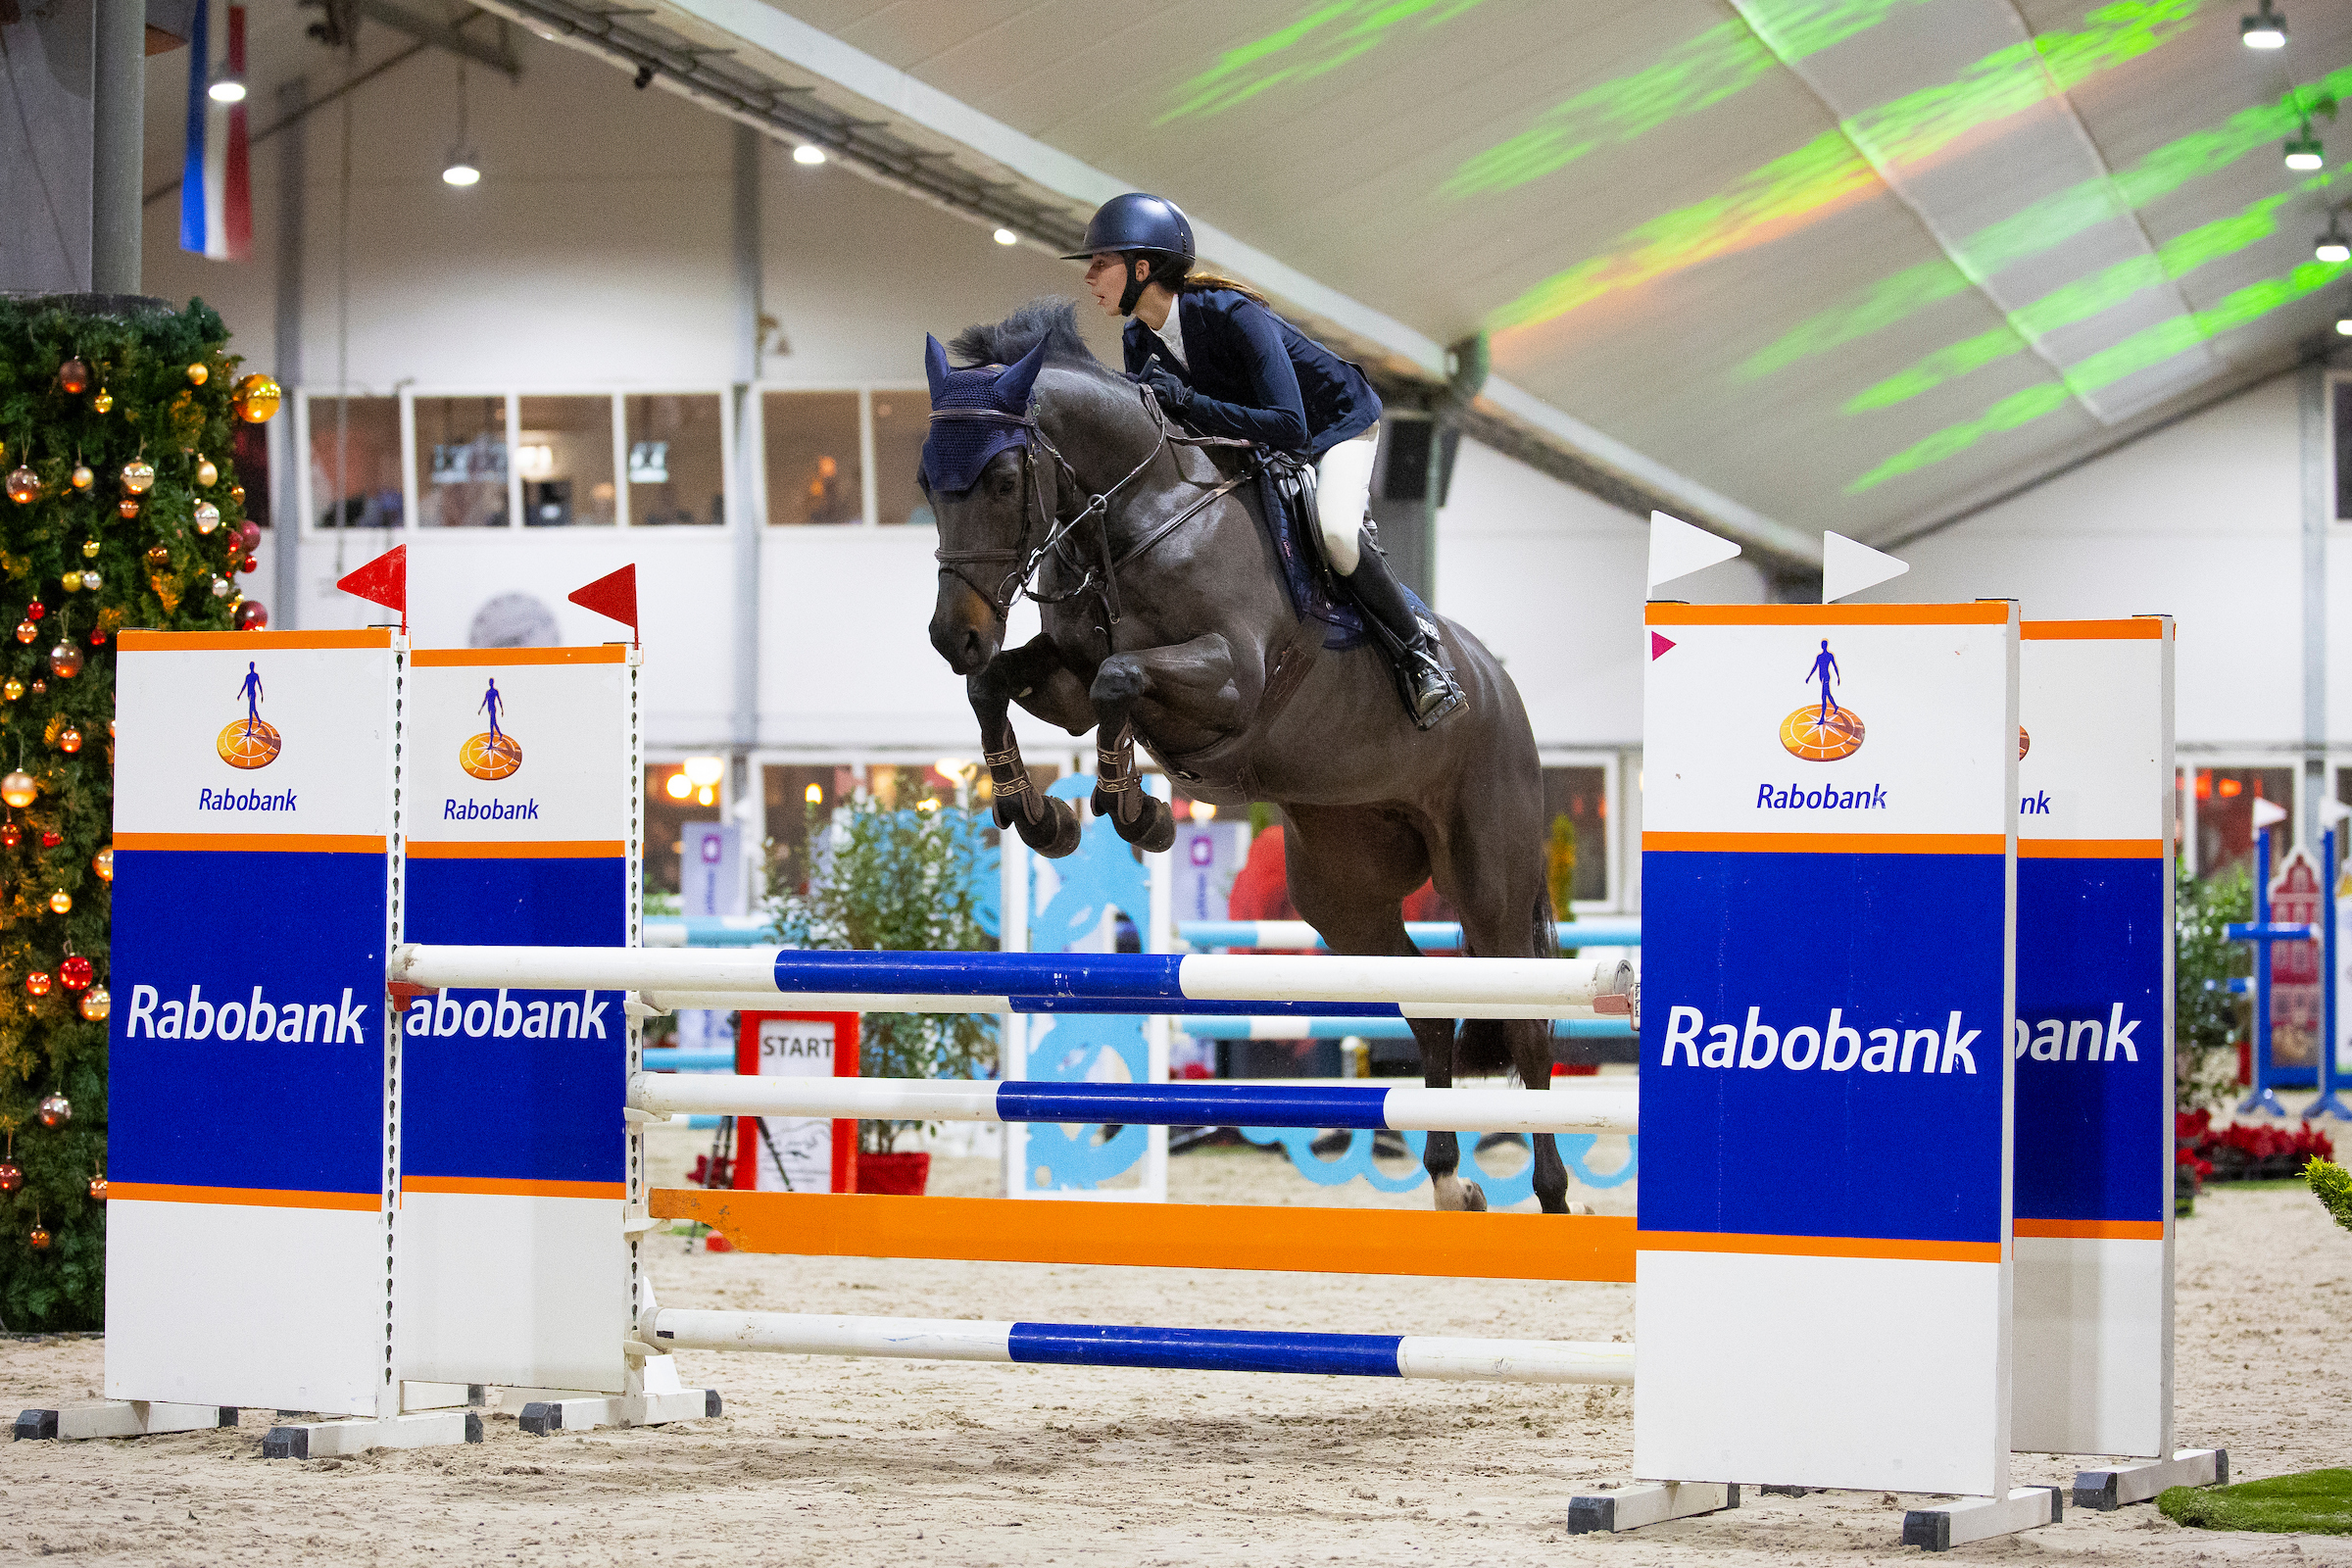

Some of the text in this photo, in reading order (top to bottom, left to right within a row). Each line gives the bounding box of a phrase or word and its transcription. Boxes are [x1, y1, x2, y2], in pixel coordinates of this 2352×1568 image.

[198, 788, 298, 811] Rabobank
[443, 798, 539, 820] Rabobank
[1756, 783, 1887, 810] Rabobank
[126, 984, 368, 1045] Rabobank
[405, 988, 610, 1039] abobank
[762, 1035, 835, 1058] START
[1660, 1005, 1983, 1075] Rabobank
